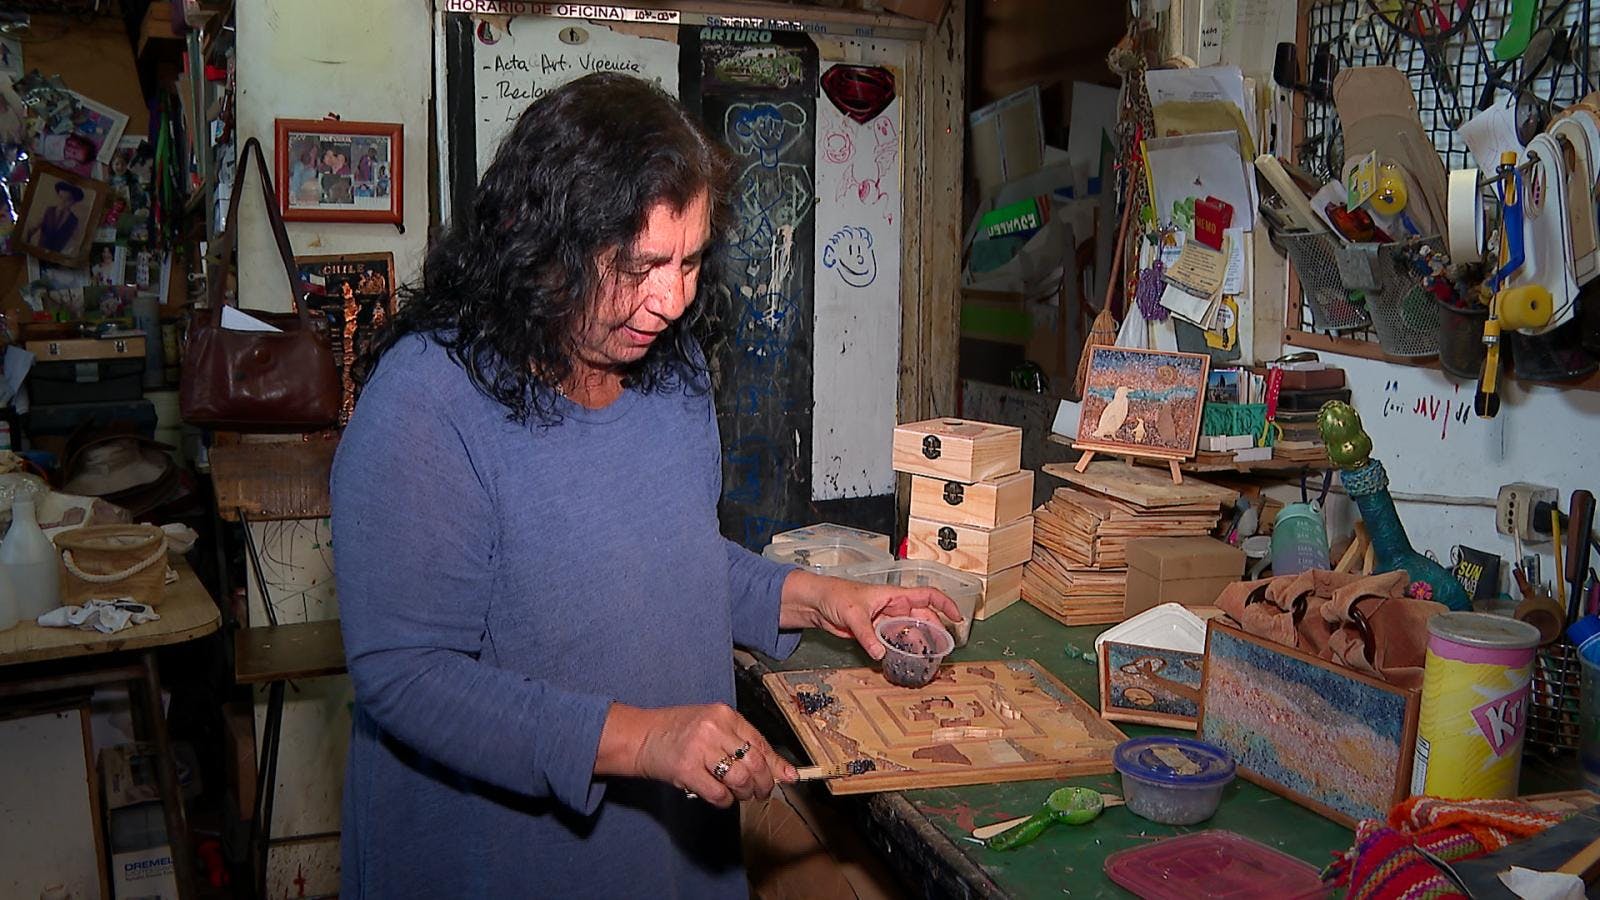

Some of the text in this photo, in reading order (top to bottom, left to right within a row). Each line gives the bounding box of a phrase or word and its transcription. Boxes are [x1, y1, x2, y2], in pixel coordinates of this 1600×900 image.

[531, 4, 551, 15] DE
[556, 4, 625, 21] OFICINA)
[700, 27, 773, 43] ARTURO
[1196, 215, 1217, 235] MEMO
[322, 264, 366, 275] CHILE
[1458, 561, 1483, 579] SUN
